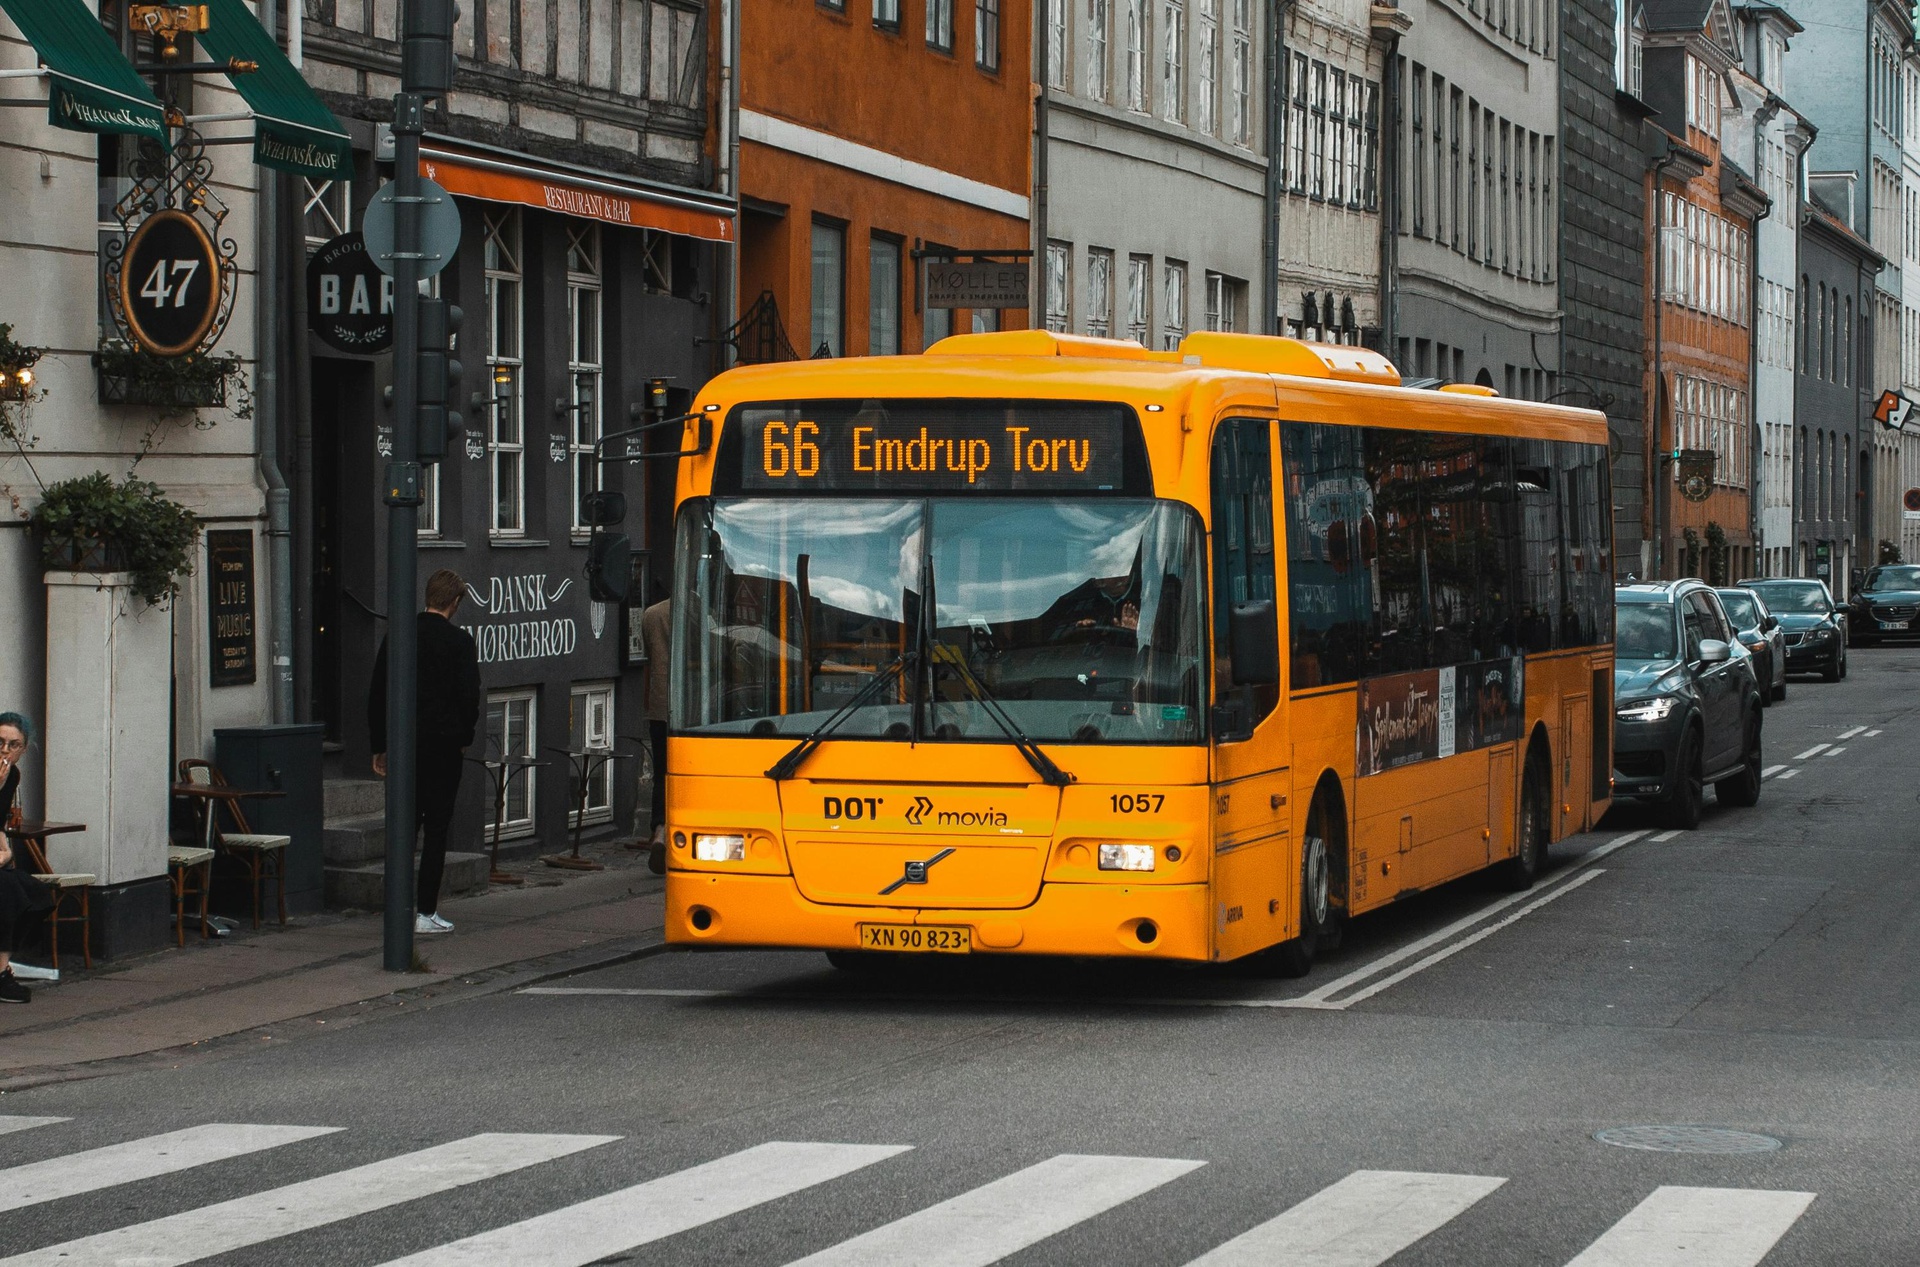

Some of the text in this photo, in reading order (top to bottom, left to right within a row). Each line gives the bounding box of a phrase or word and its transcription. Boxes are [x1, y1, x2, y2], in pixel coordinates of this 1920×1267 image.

[543, 185, 631, 223] RESTAURANT & BAR
[140, 259, 199, 308] 47
[928, 271, 1028, 290] MØLLER
[320, 274, 395, 314] BAR
[763, 421, 1090, 484] 66 Emdrup Torv
[220, 581, 246, 605] LIVE
[490, 574, 547, 614] DANSK
[217, 613, 251, 638] MUSIC
[460, 618, 576, 663] MØRREBRØD
[824, 796, 883, 820] DOT
[938, 806, 1008, 826] movia
[1110, 794, 1165, 813] 1057
[871, 928, 962, 949] XN 90 823
